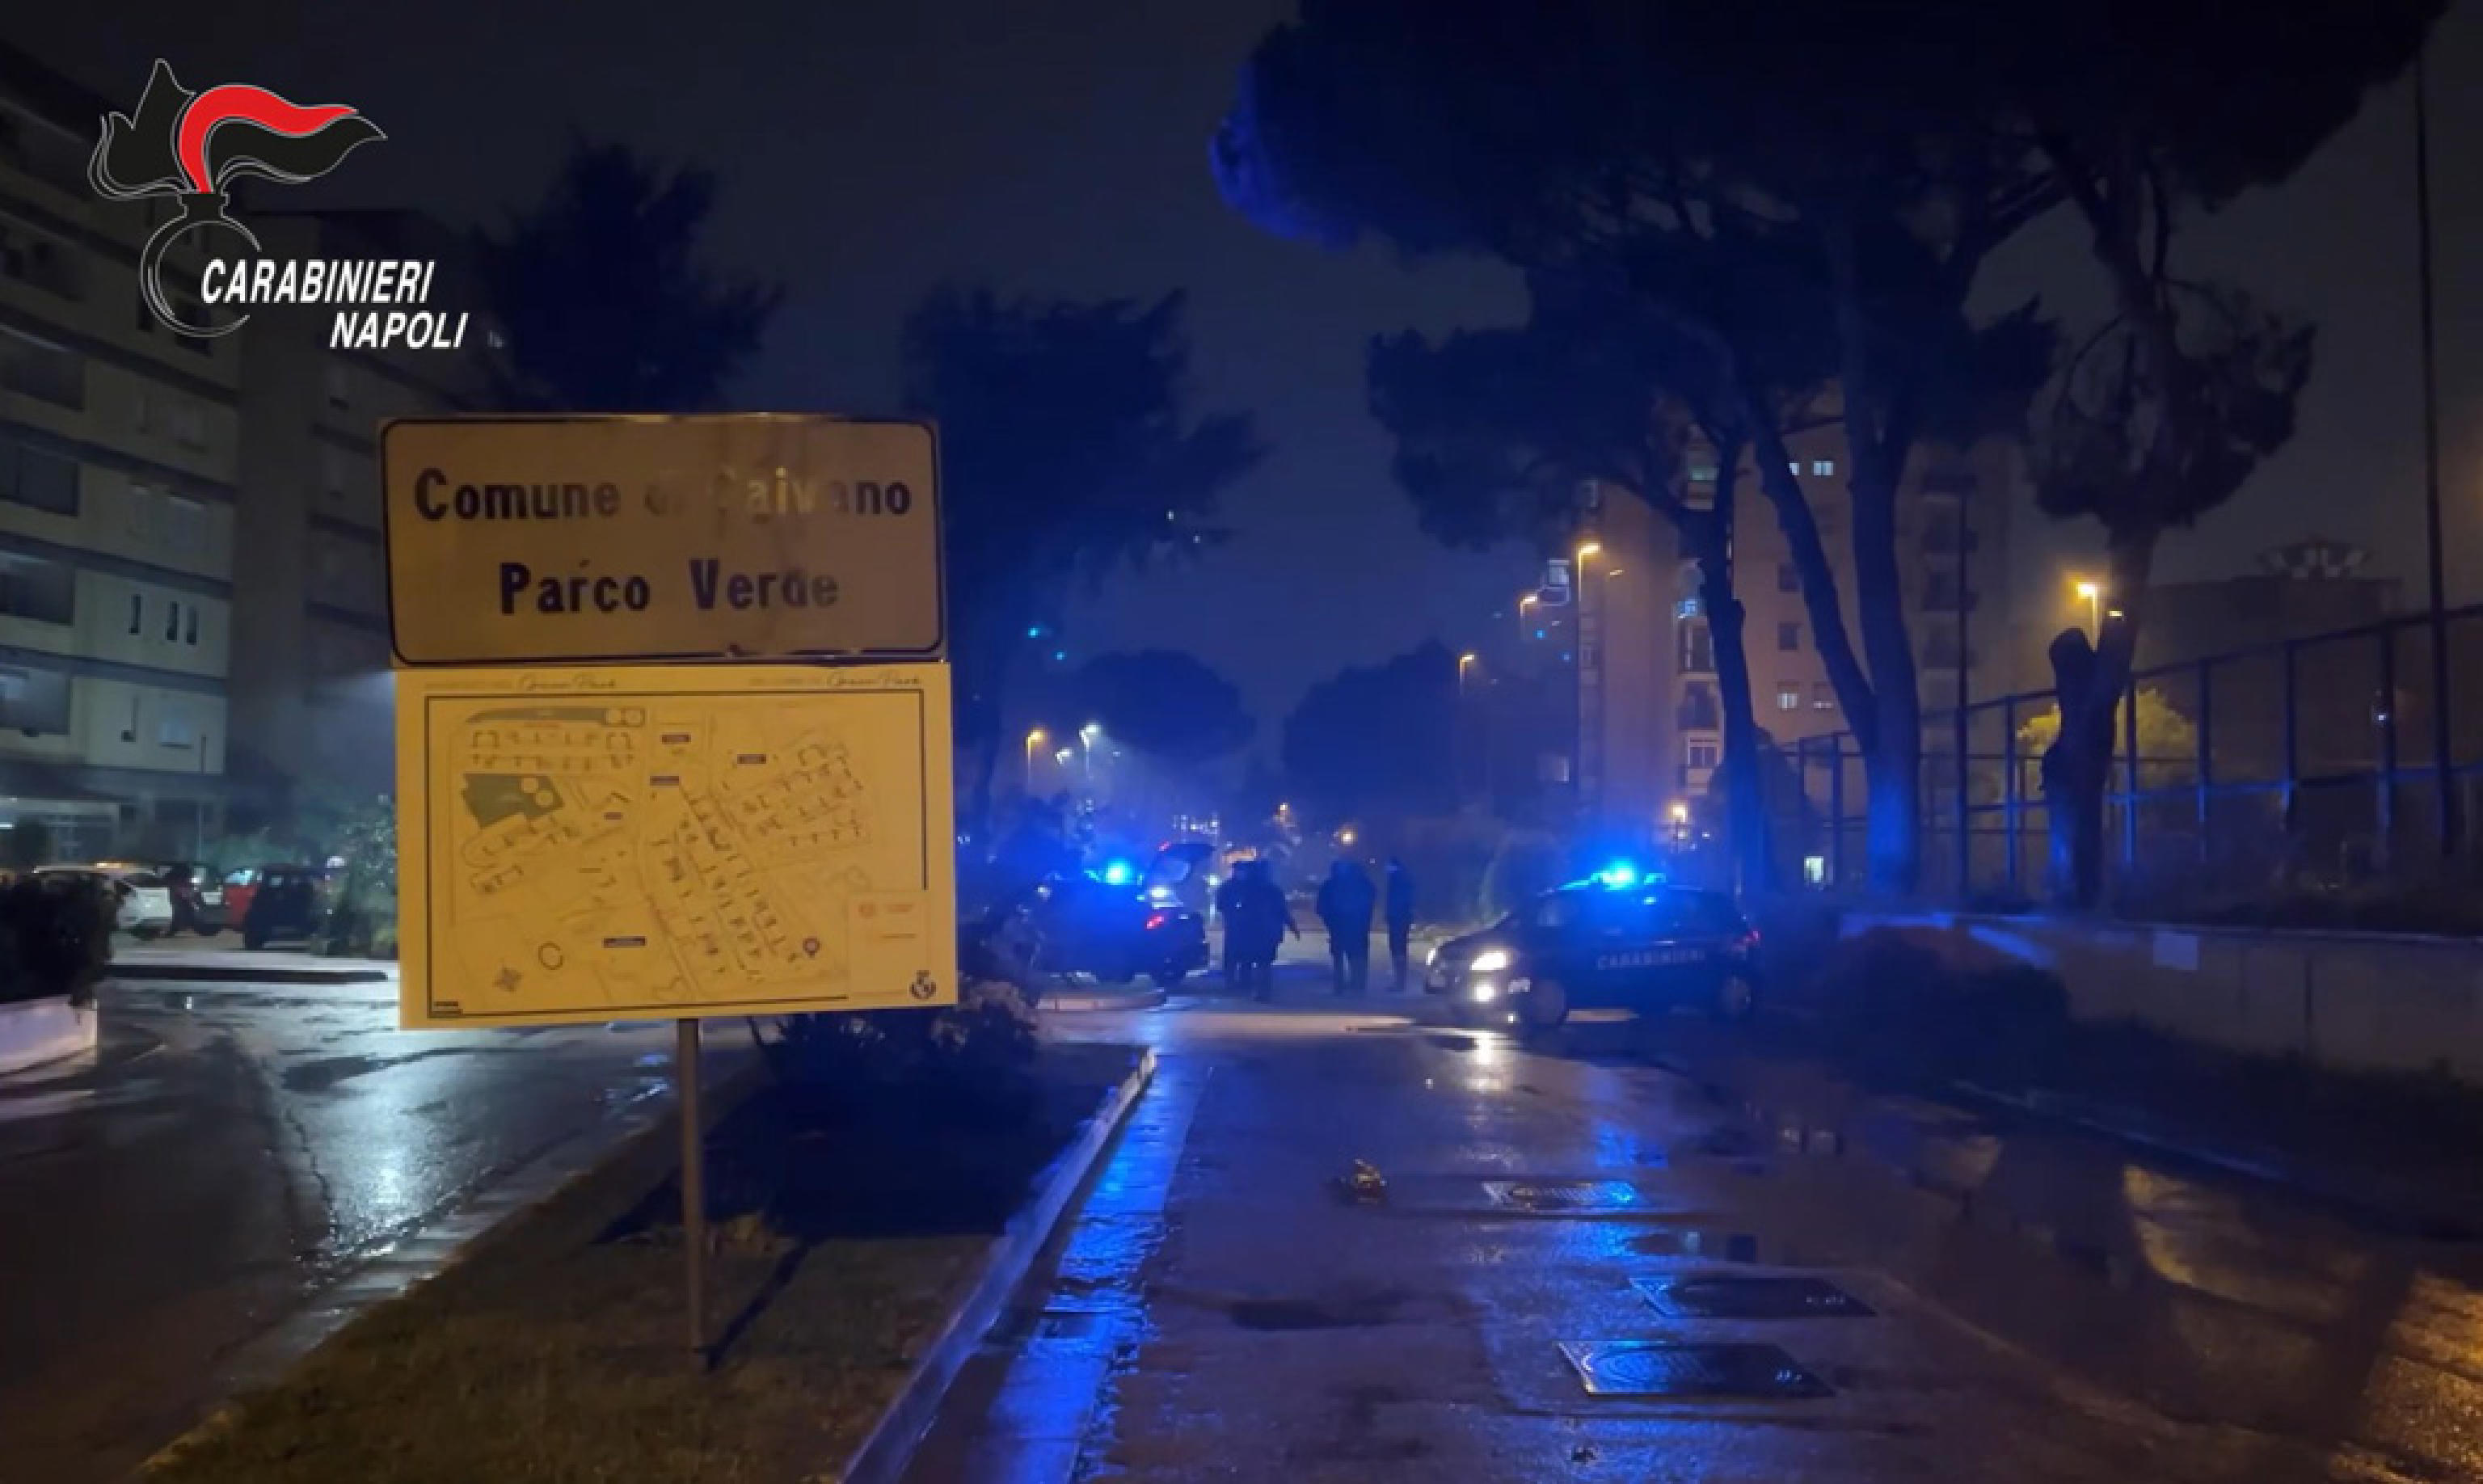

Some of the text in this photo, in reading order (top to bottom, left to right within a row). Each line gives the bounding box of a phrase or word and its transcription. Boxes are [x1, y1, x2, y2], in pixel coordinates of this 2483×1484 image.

[415, 467, 620, 520] Comune
[500, 558, 839, 614] Parco Verde
